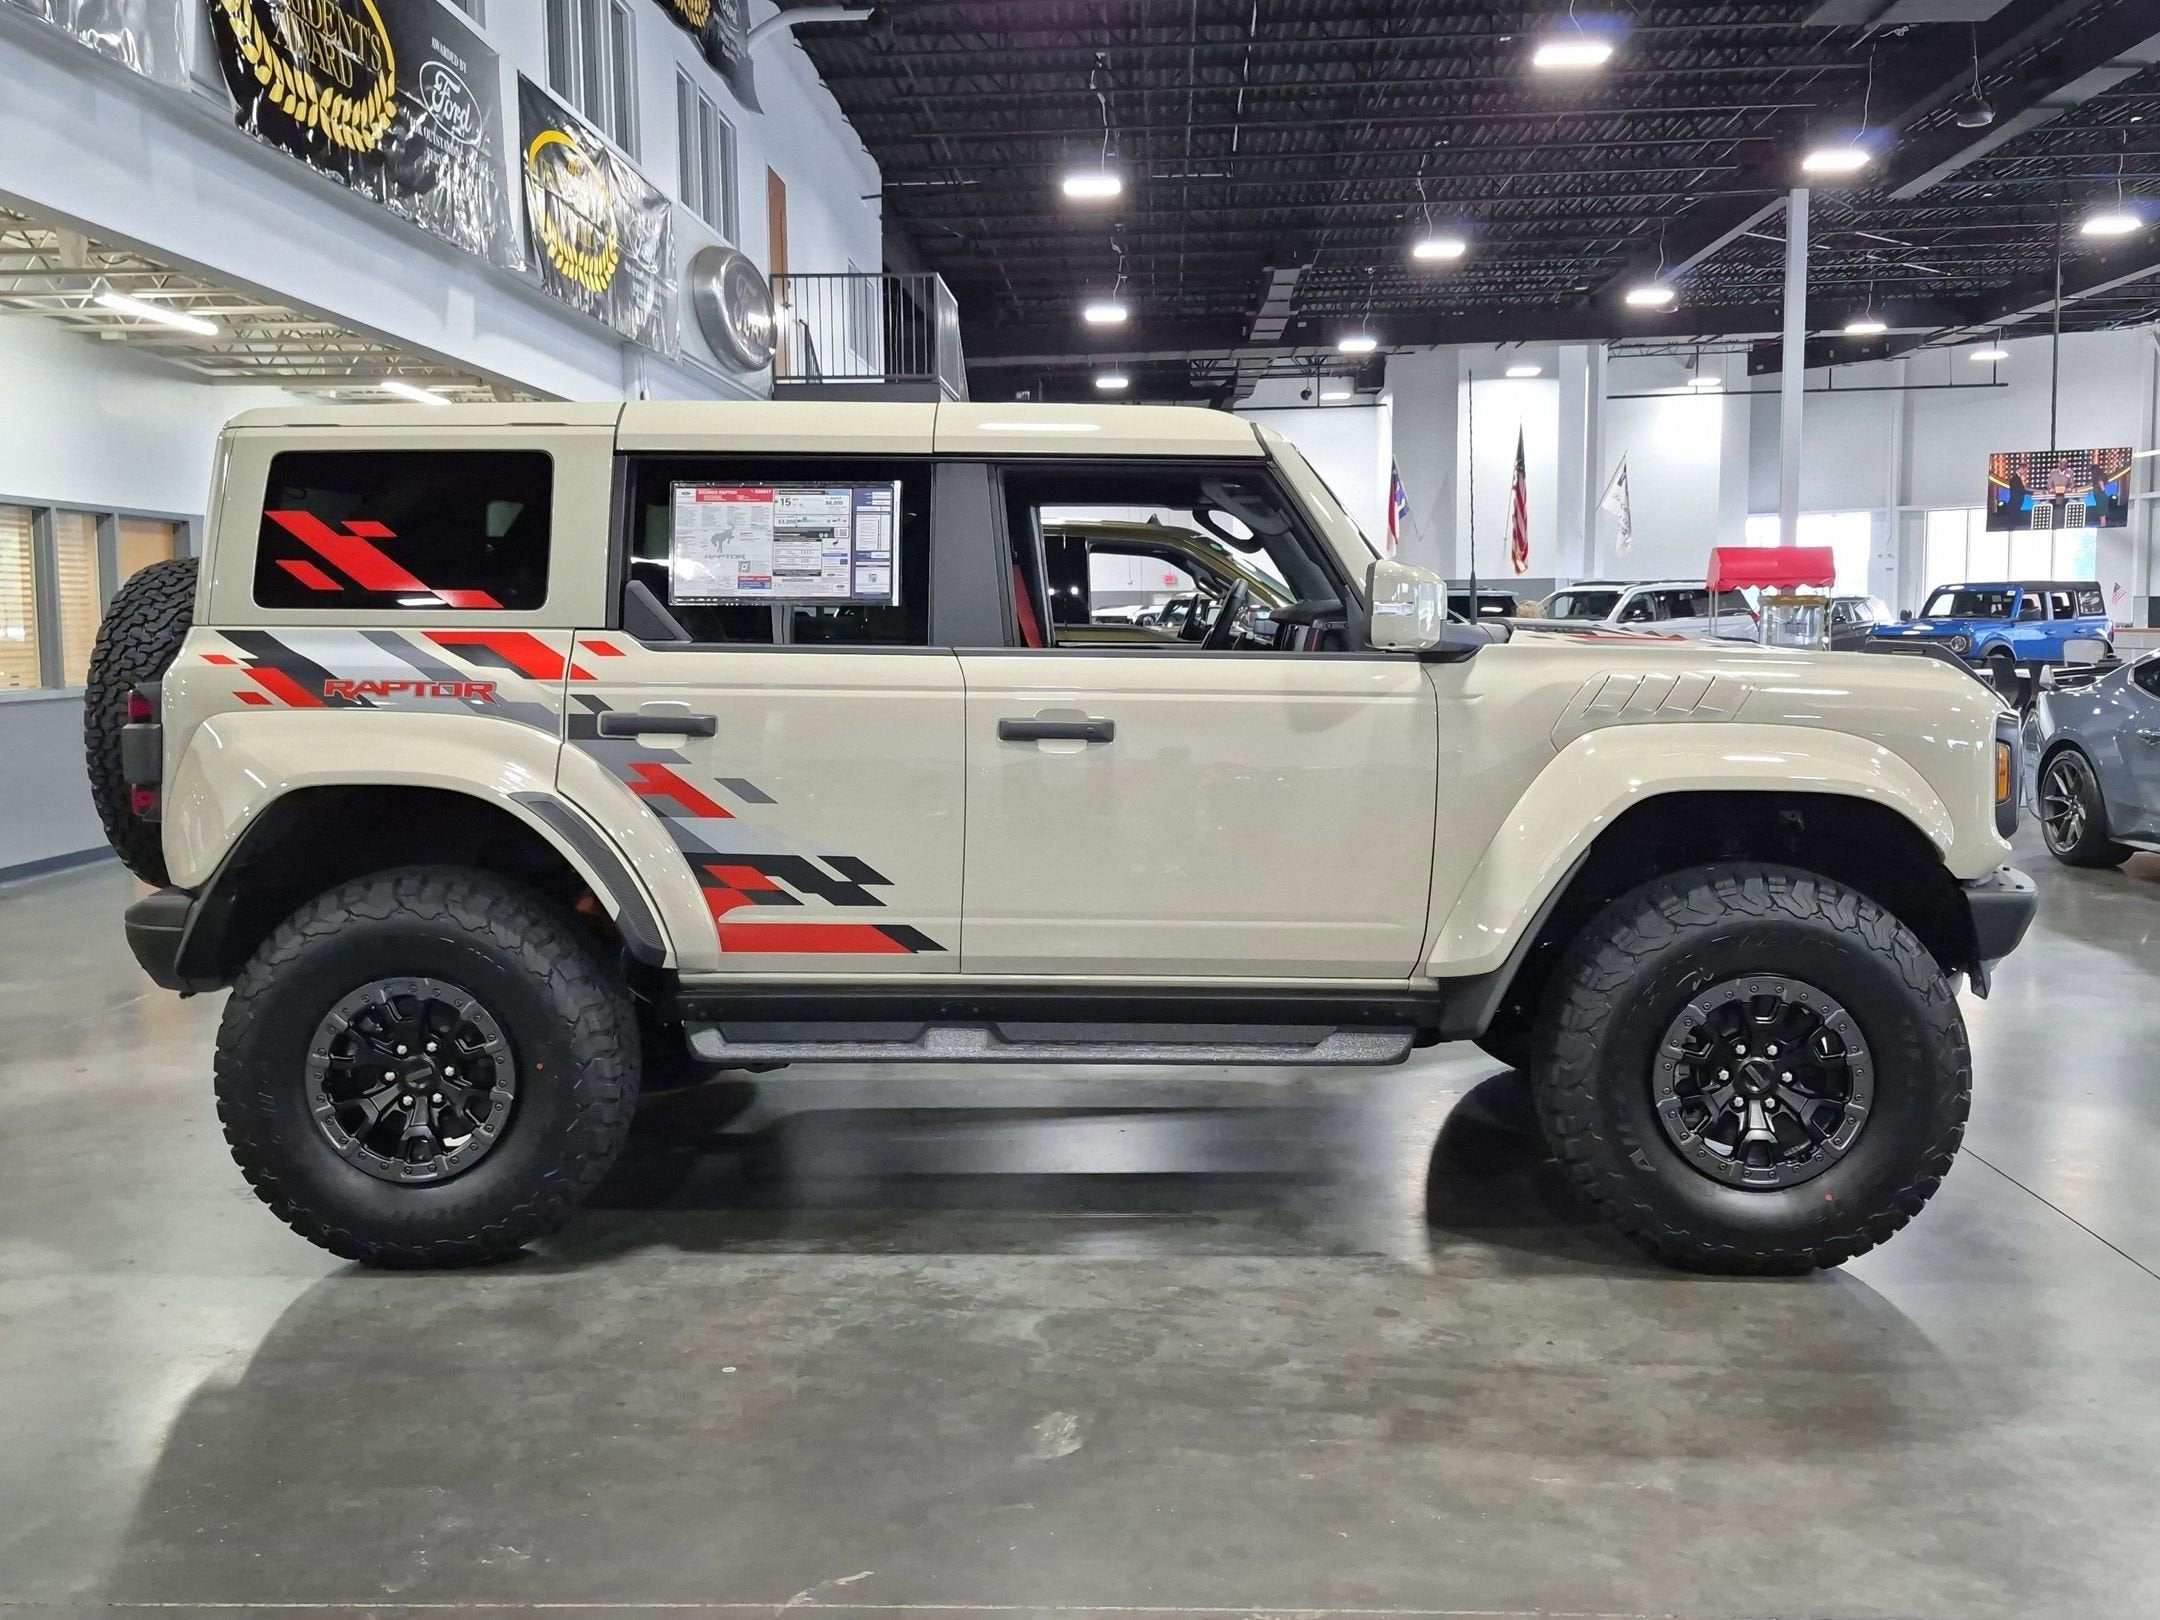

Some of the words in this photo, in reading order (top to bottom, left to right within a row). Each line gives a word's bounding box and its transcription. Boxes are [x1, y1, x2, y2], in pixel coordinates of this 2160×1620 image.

[431, 36, 459, 67] AWARDED
[459, 58, 467, 74] BY
[432, 70, 472, 134] Ford
[780, 497, 791, 507] 15
[323, 680, 500, 706] RAPTOR
